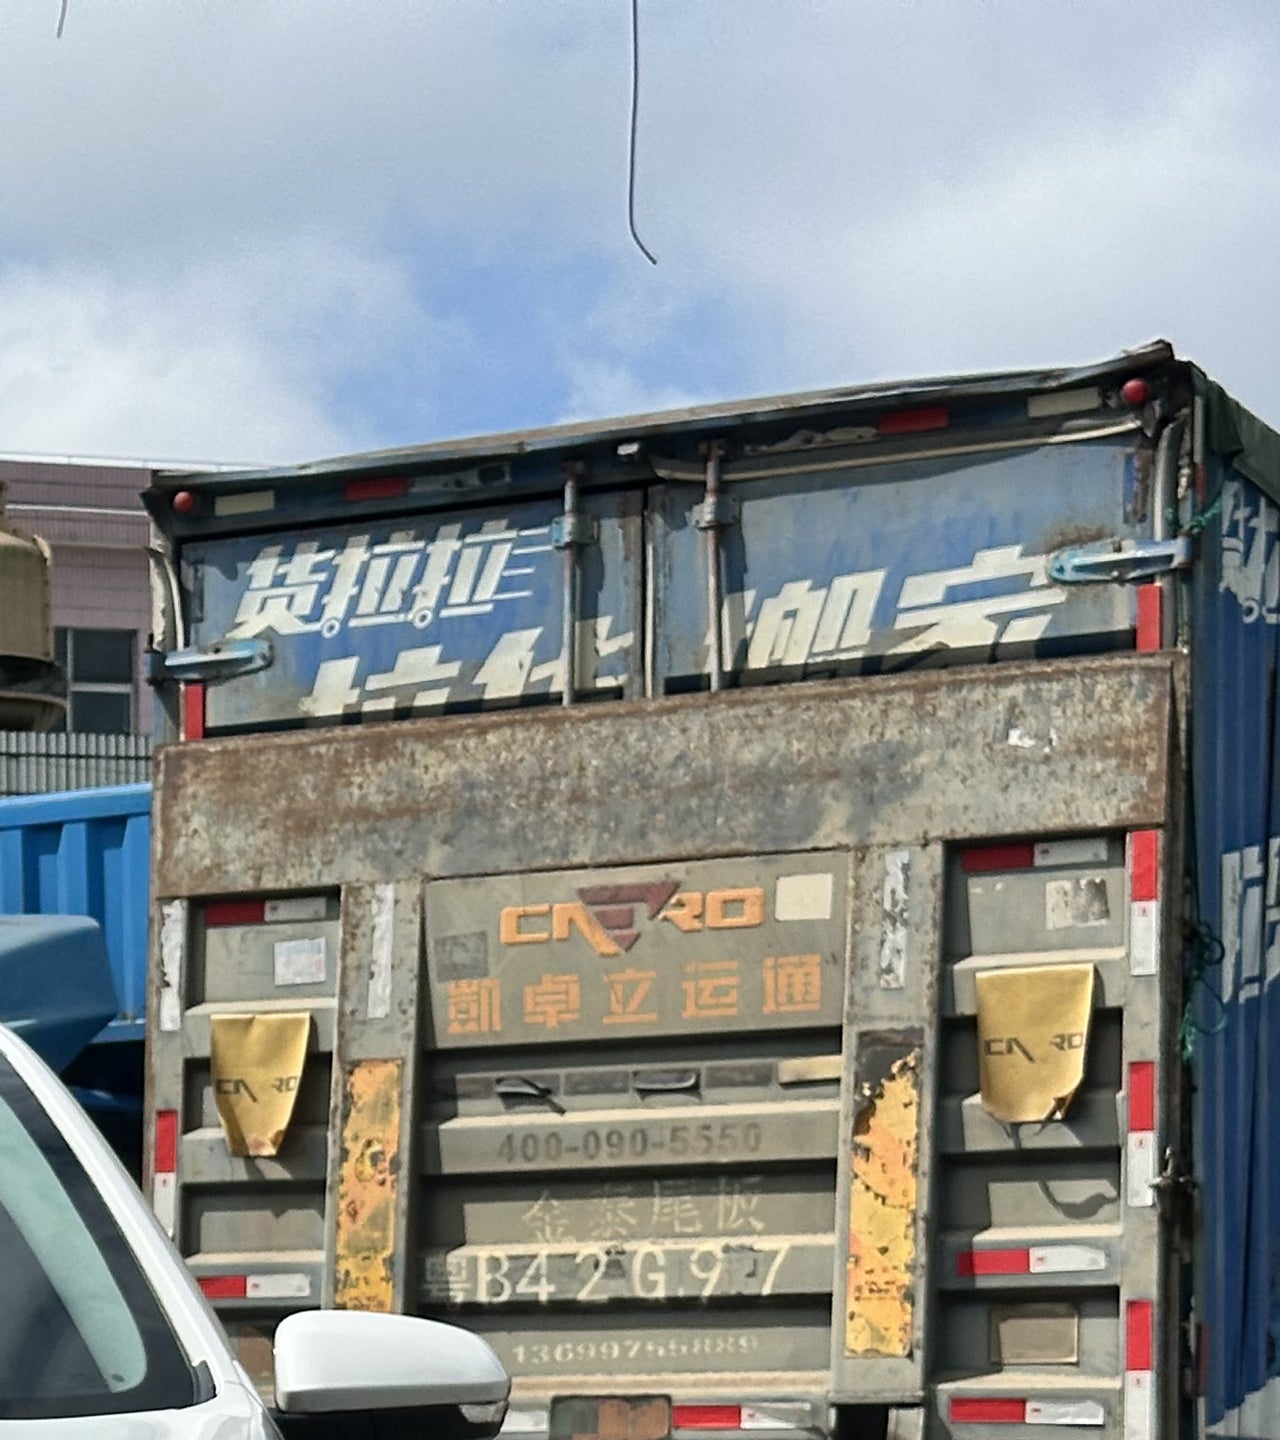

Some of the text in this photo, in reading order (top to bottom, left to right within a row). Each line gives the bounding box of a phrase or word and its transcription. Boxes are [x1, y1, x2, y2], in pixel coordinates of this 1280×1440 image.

[225, 519, 522, 638] 货拉拉
[496, 1122, 764, 1164] 400-090-5550
